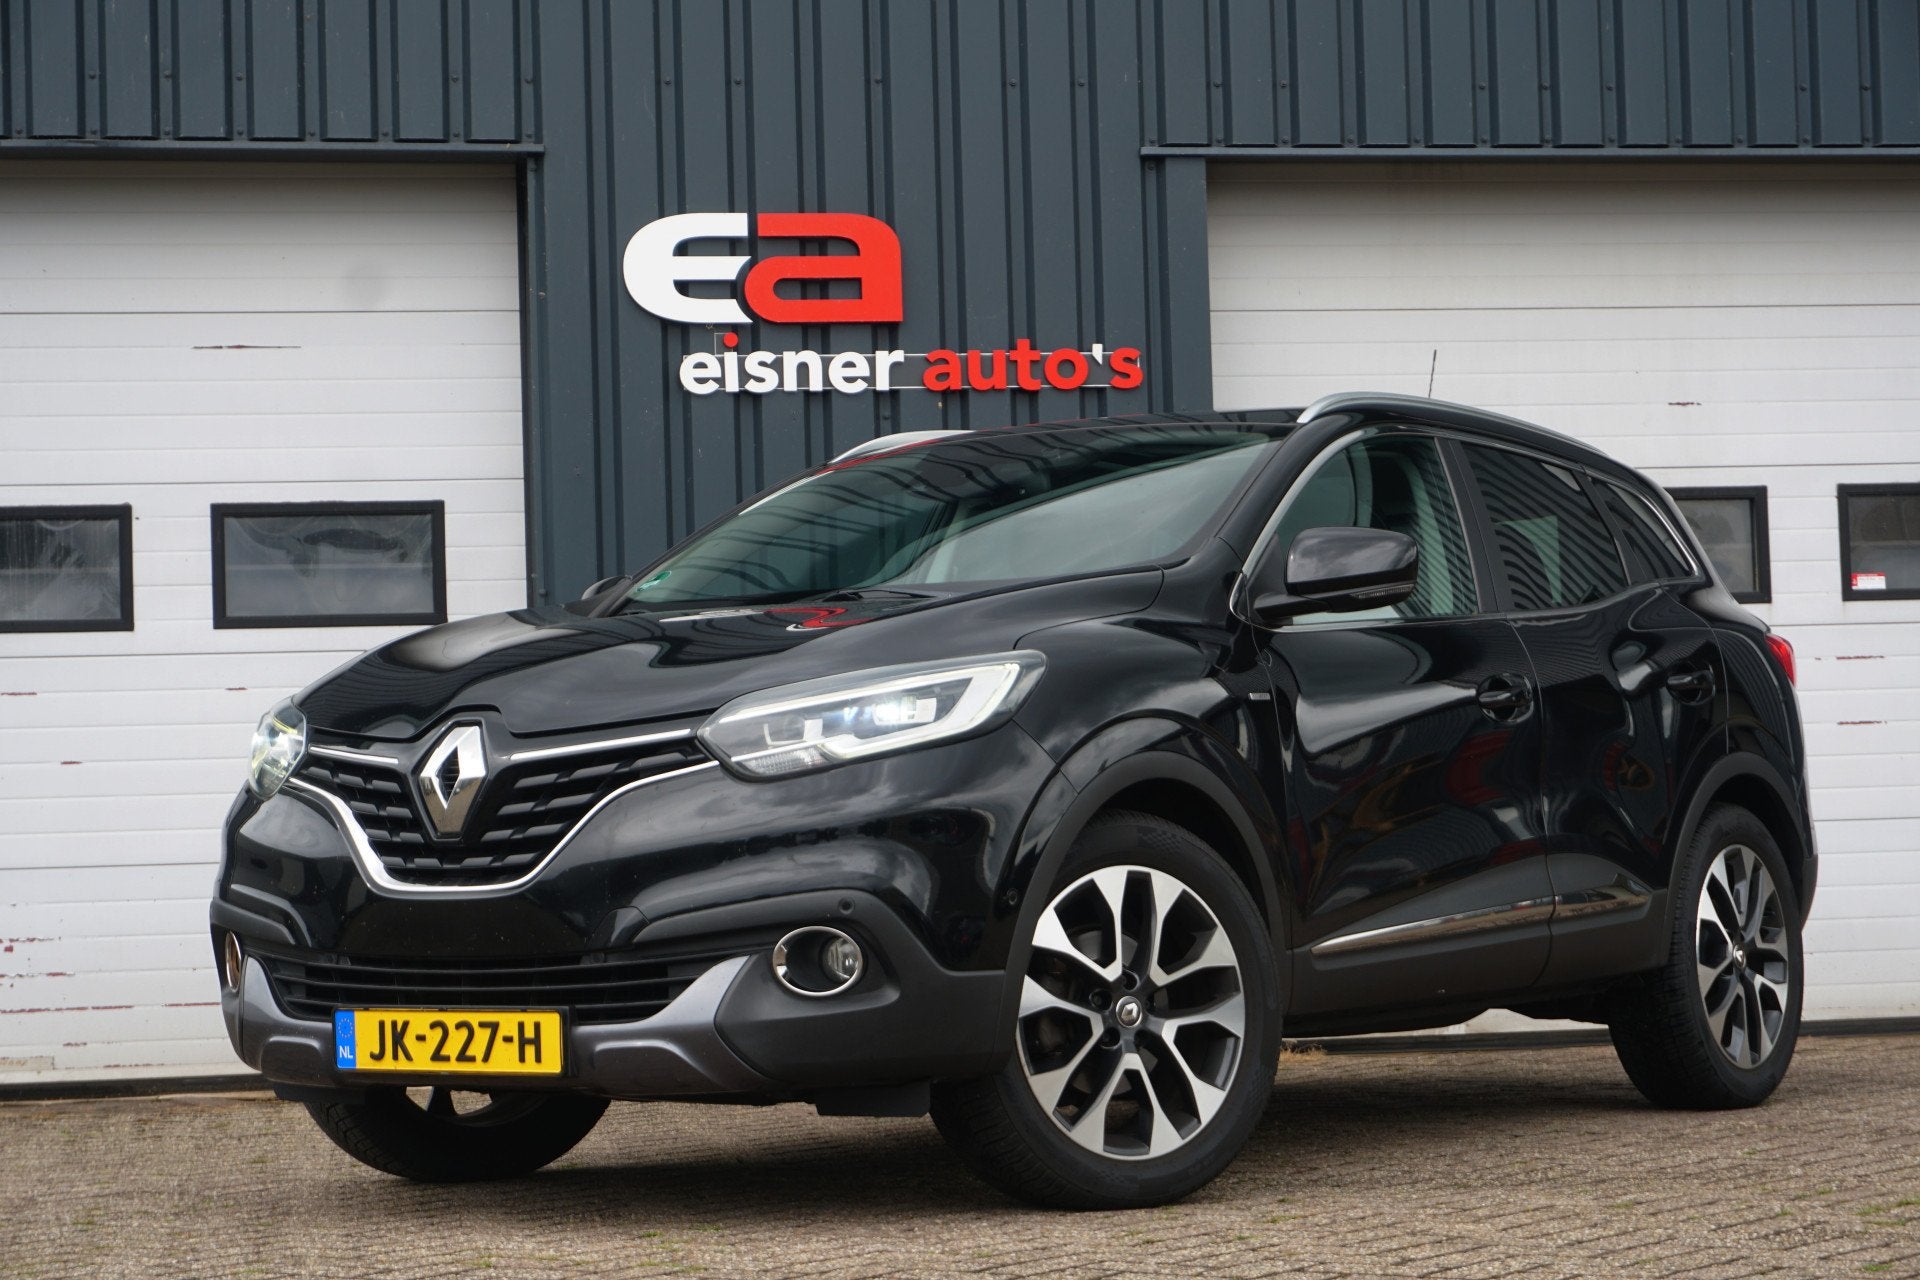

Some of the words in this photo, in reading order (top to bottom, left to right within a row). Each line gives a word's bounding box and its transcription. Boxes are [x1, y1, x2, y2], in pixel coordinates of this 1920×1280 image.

[679, 332, 904, 395] eisner
[922, 338, 1144, 391] auto's
[339, 1045, 354, 1060] NL
[369, 1019, 542, 1064] JK-227-H
